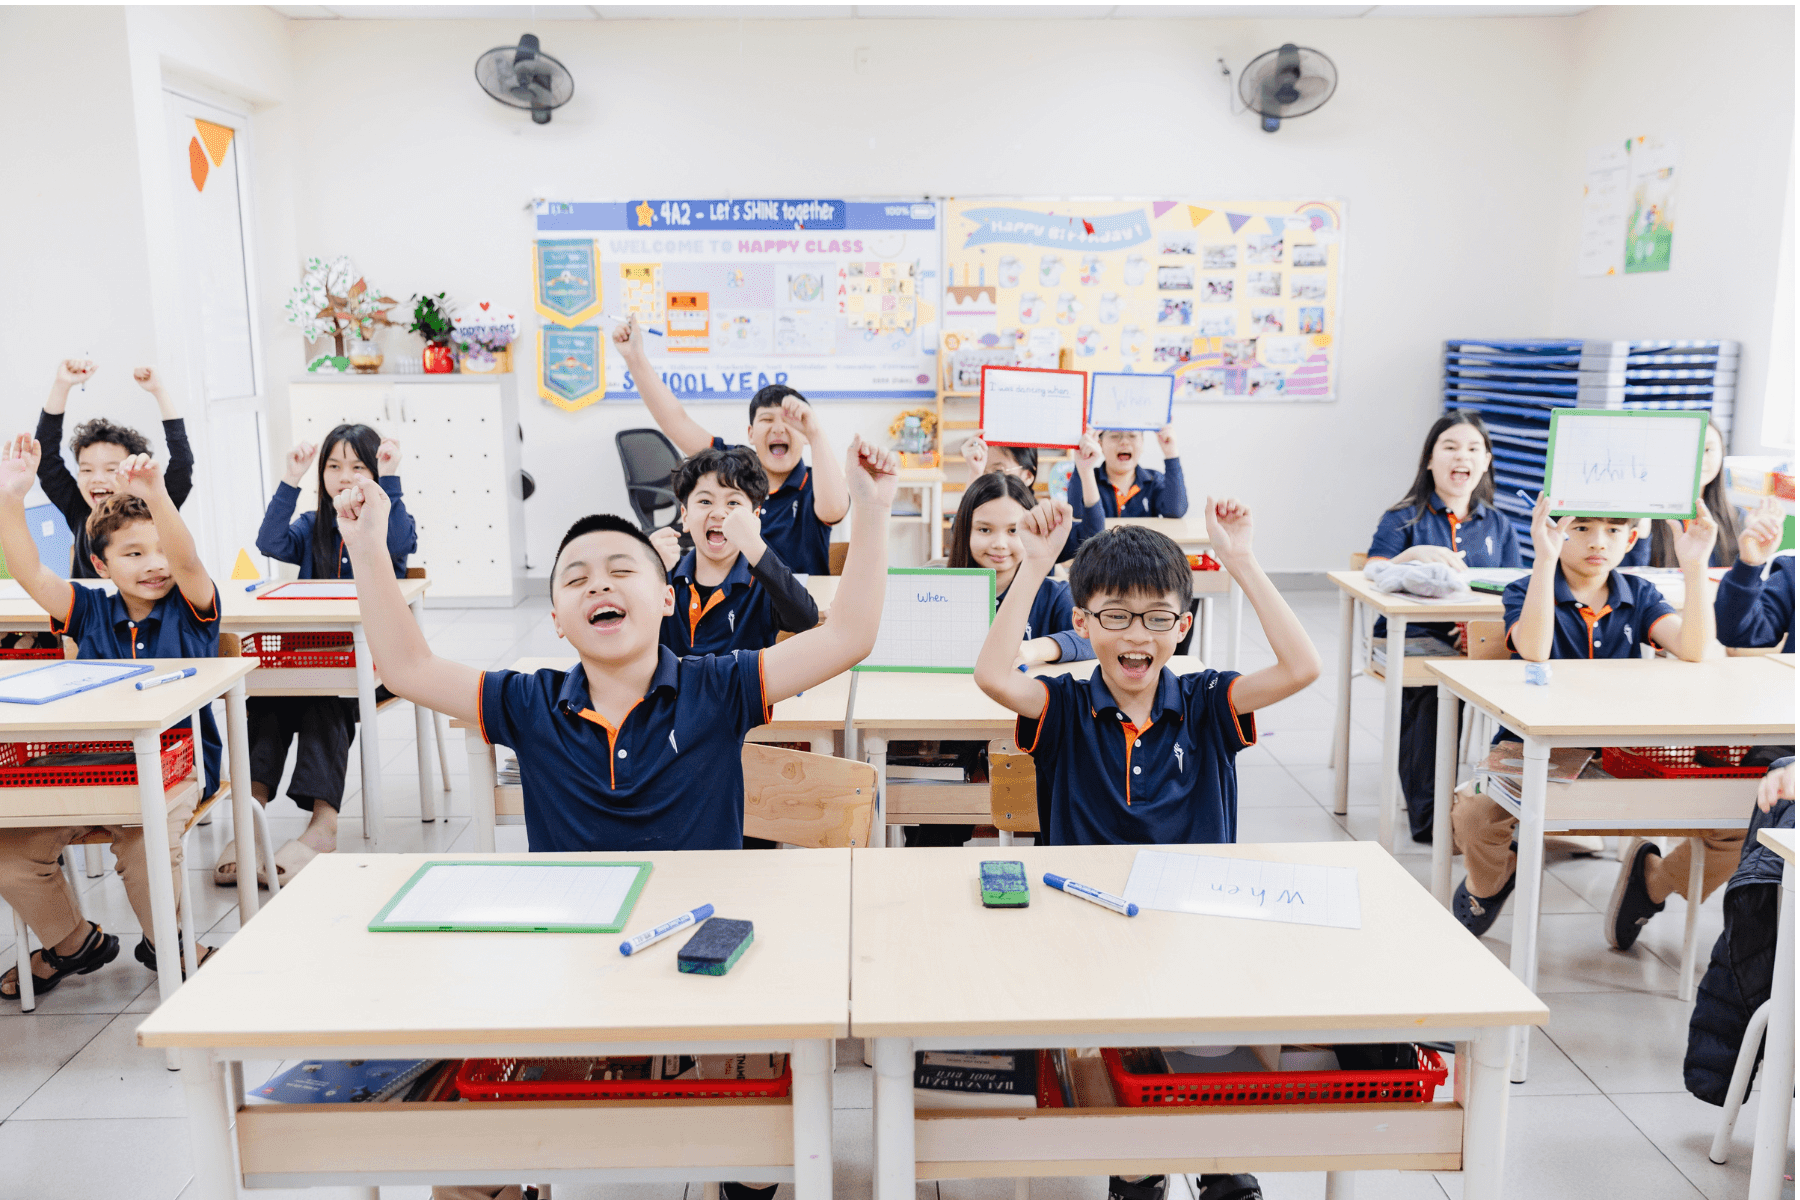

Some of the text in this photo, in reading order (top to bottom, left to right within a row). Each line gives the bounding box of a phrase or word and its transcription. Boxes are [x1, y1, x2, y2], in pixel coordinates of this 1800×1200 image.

[660, 201, 691, 225] 4A2
[709, 201, 741, 221] Let's
[742, 201, 780, 221] SHINE
[782, 200, 835, 229] together
[991, 219, 1045, 237] Happy
[609, 239, 864, 254] WELCOME TO HAPPY CLASS
[622, 370, 789, 394] SOOL YEAR
[1047, 385, 1070, 397] when
[916, 591, 949, 603] When
